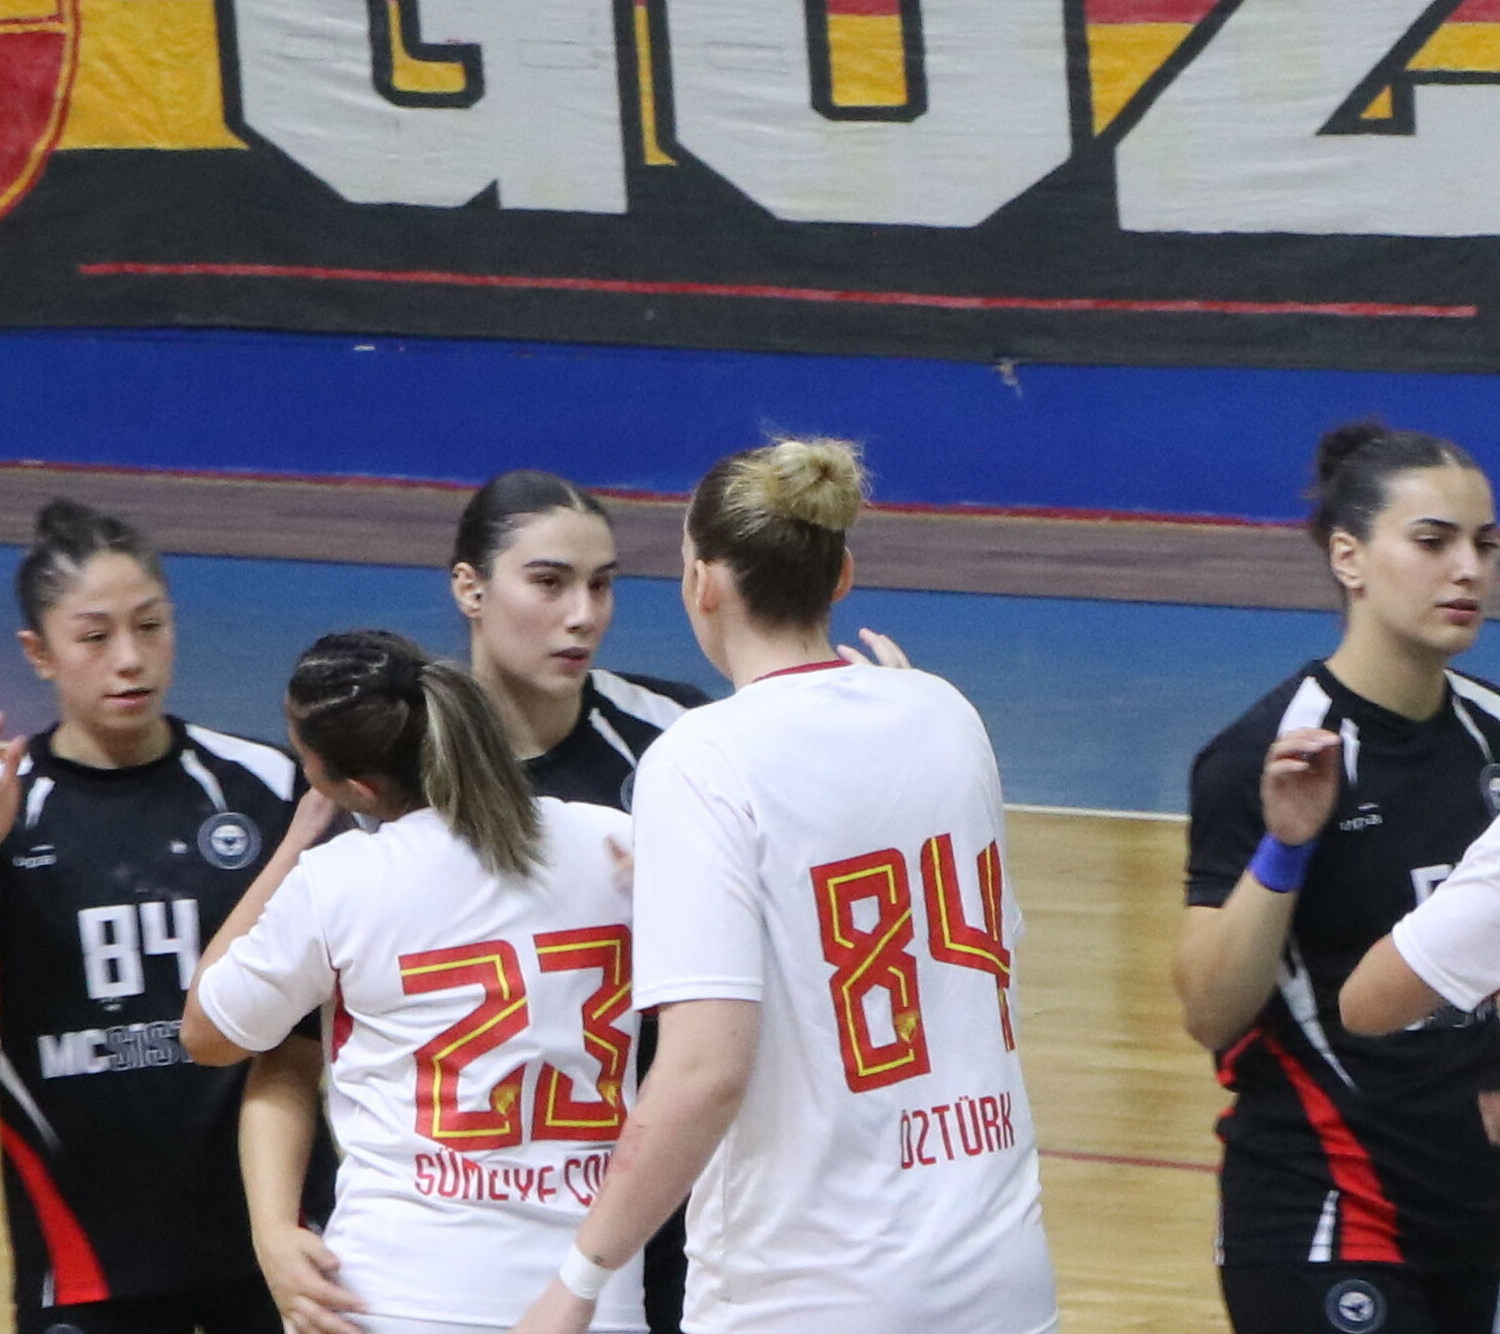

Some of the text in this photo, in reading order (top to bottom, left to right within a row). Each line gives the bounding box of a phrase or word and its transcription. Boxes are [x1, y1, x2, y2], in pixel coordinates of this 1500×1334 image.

[77, 898, 201, 1000] 84
[398, 923, 633, 1152] 23
[809, 833, 1016, 1093] 84
